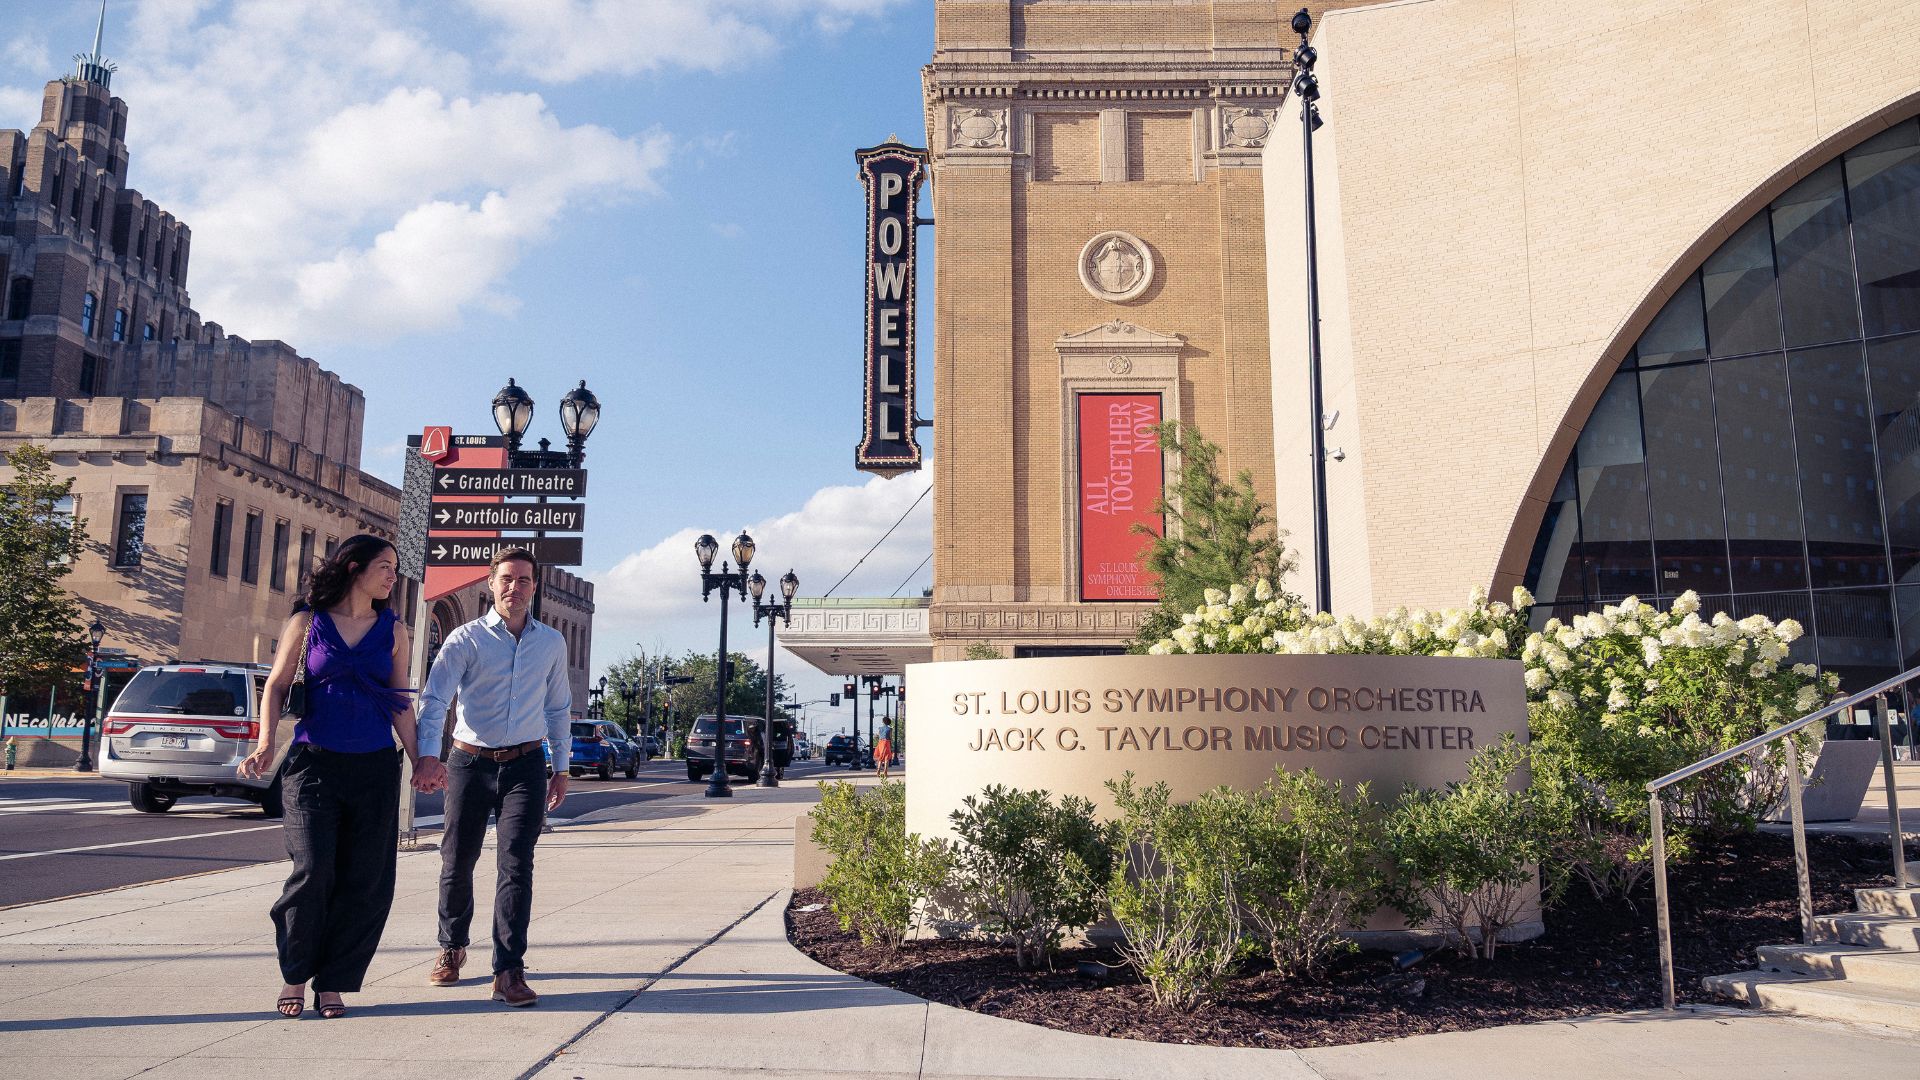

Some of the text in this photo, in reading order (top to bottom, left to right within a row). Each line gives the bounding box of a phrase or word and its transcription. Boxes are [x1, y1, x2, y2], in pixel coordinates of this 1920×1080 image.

[874, 172, 906, 440] POWELL
[454, 436, 487, 445] ST. LOUIS
[1133, 402, 1156, 453] NOW
[1109, 402, 1133, 516] TOGETHER
[459, 474, 574, 490] Grandel Theatre
[1087, 476, 1109, 515] ALL
[455, 508, 577, 528] Portfolio Gallery
[1088, 574, 1137, 585] SYMPHONY
[1100, 562, 1139, 573] ST. LOUIS
[953, 687, 1486, 715] ST. LOUIS SYMPHONY ORCHESTRA
[968, 725, 1475, 752] JACK C. TAYLOR MUSIC CENTER
